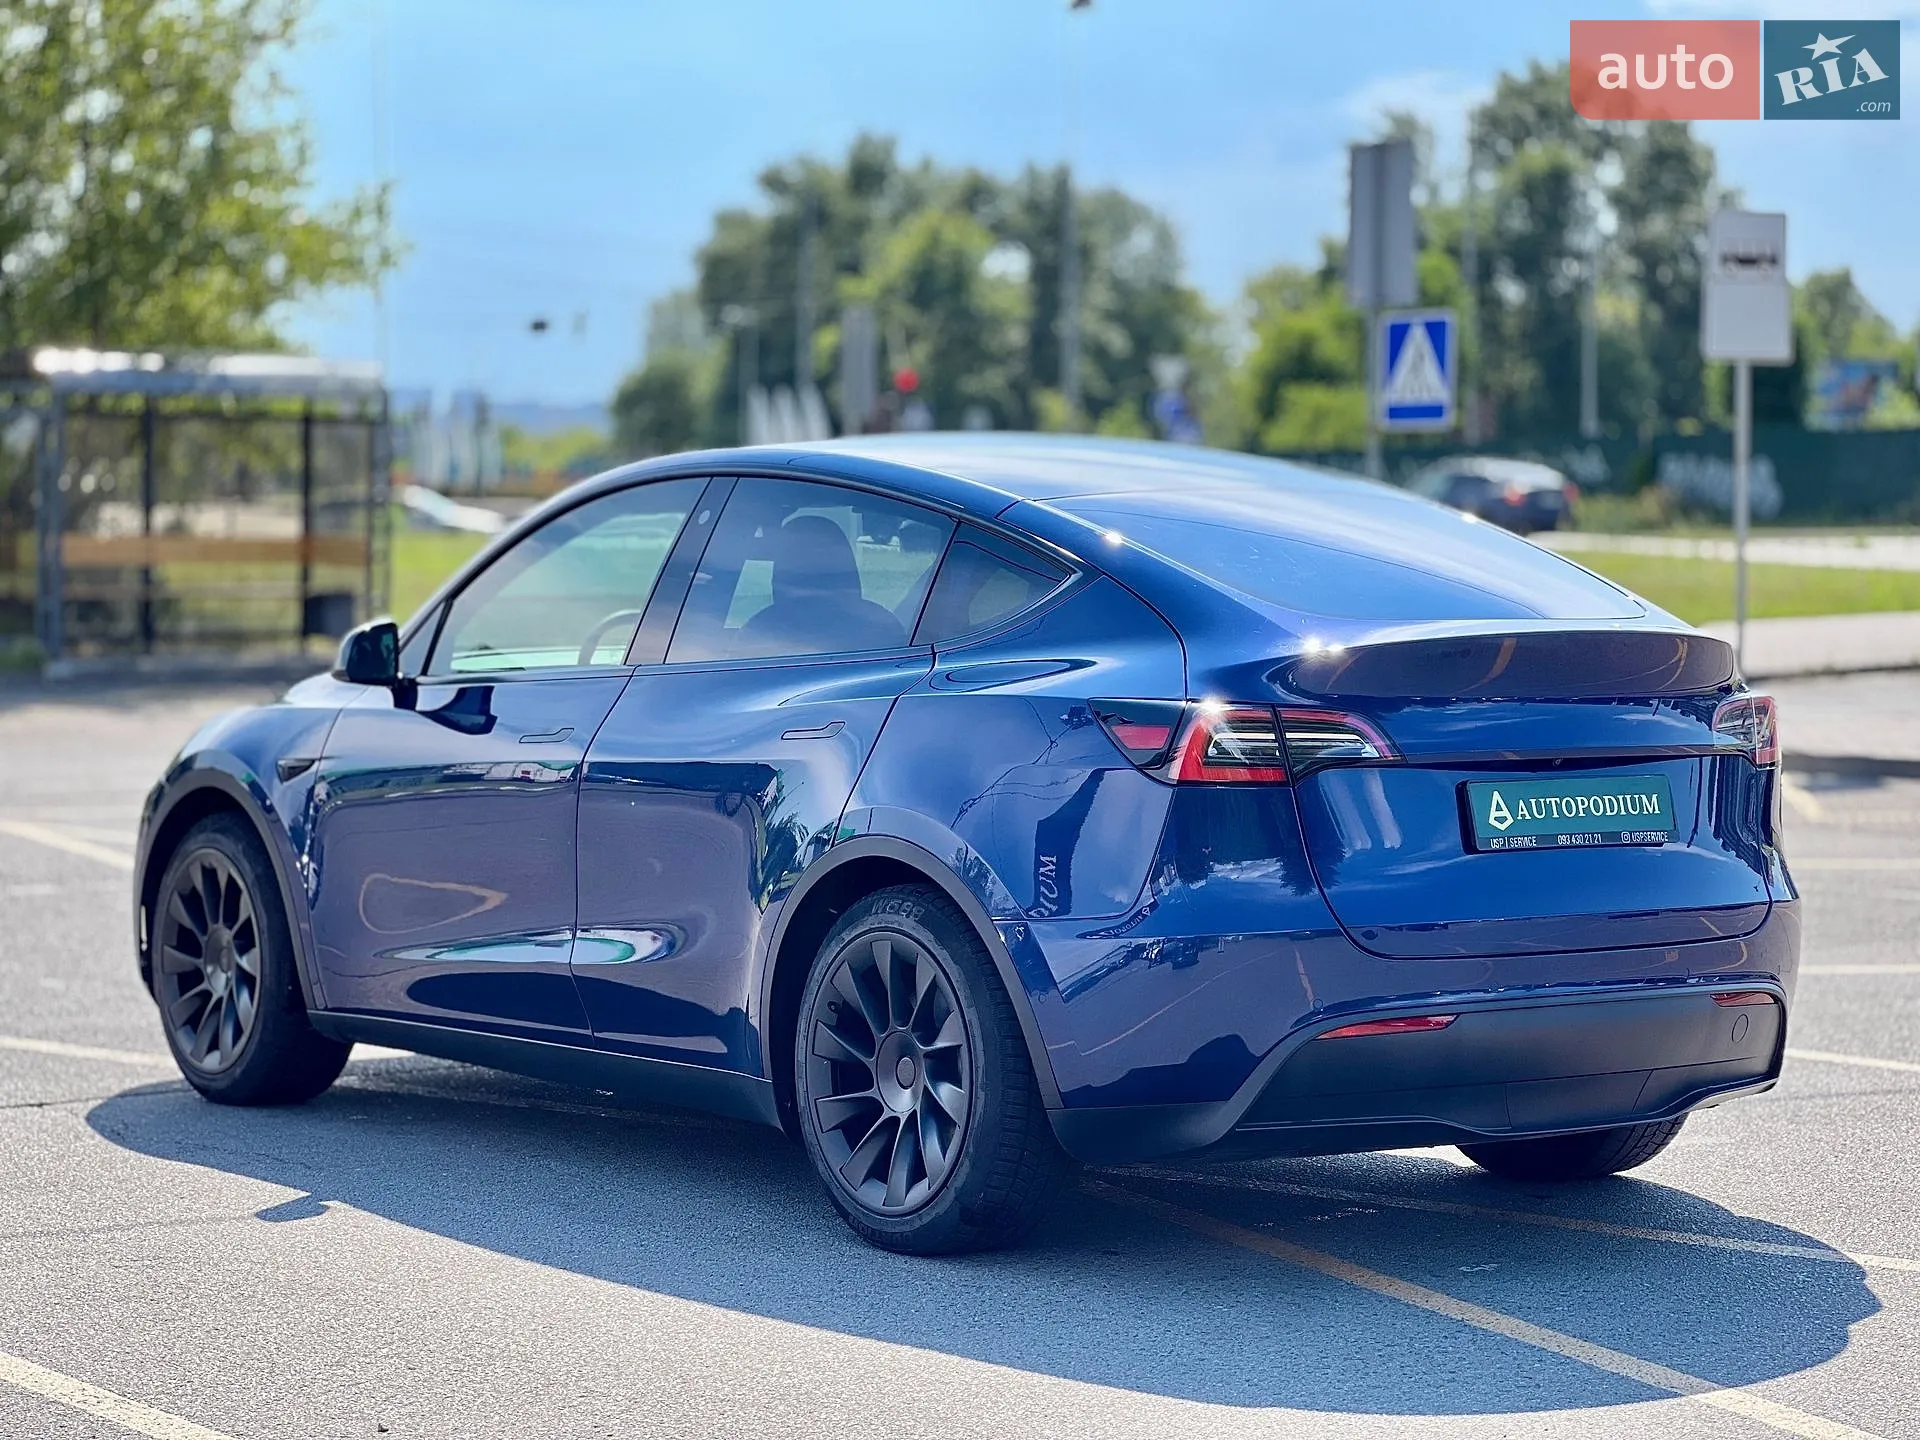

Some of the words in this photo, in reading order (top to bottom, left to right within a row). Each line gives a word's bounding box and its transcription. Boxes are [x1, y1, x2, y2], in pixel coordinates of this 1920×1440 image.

[1516, 793, 1661, 821] AUTOPODIUM
[1490, 838, 1504, 849] USP
[1509, 836, 1537, 848] SERVICE
[1557, 834, 1571, 845] 093
[1571, 833, 1584, 845] 430
[1585, 833, 1593, 844] 21
[1594, 833, 1602, 844] 21
[1631, 831, 1669, 842] USPSERVICE
